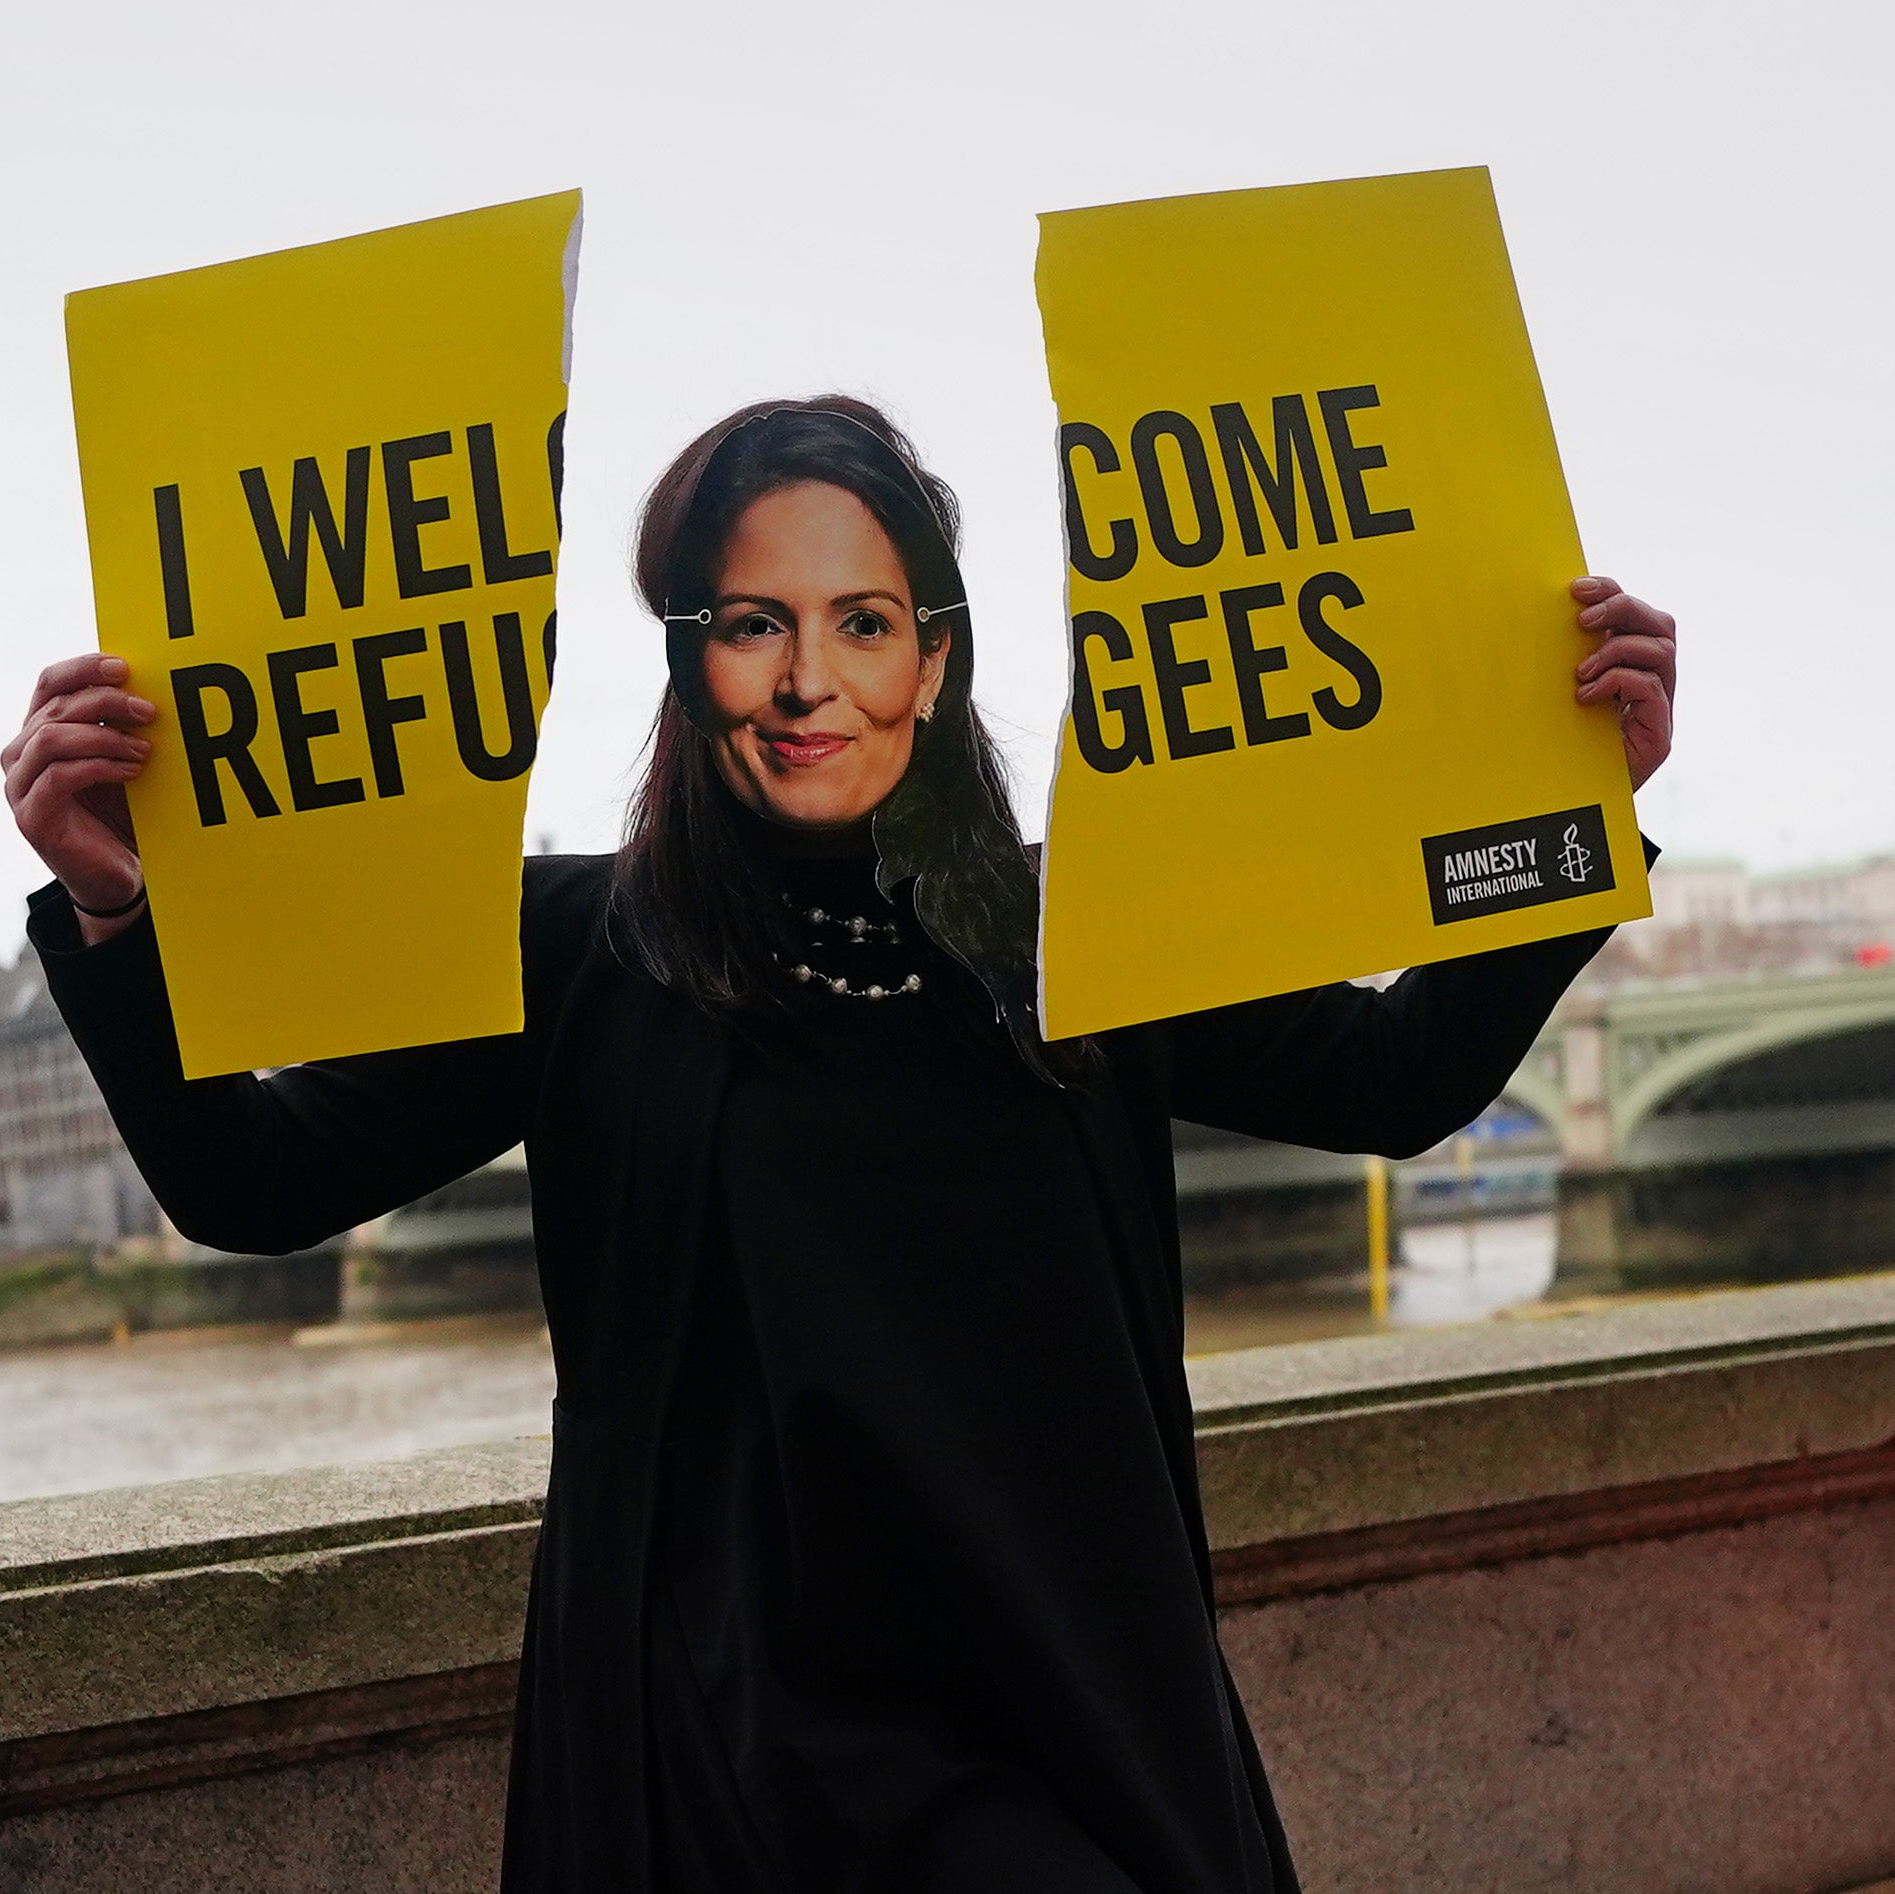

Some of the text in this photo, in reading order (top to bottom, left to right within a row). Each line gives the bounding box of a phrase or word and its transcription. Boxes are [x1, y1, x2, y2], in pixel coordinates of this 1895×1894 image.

[152, 409, 568, 640] I WEL
[169, 607, 560, 829] REFU
[1444, 838, 1537, 884] AMNESTY
[1446, 870, 1545, 906] INTERNATIONAL
